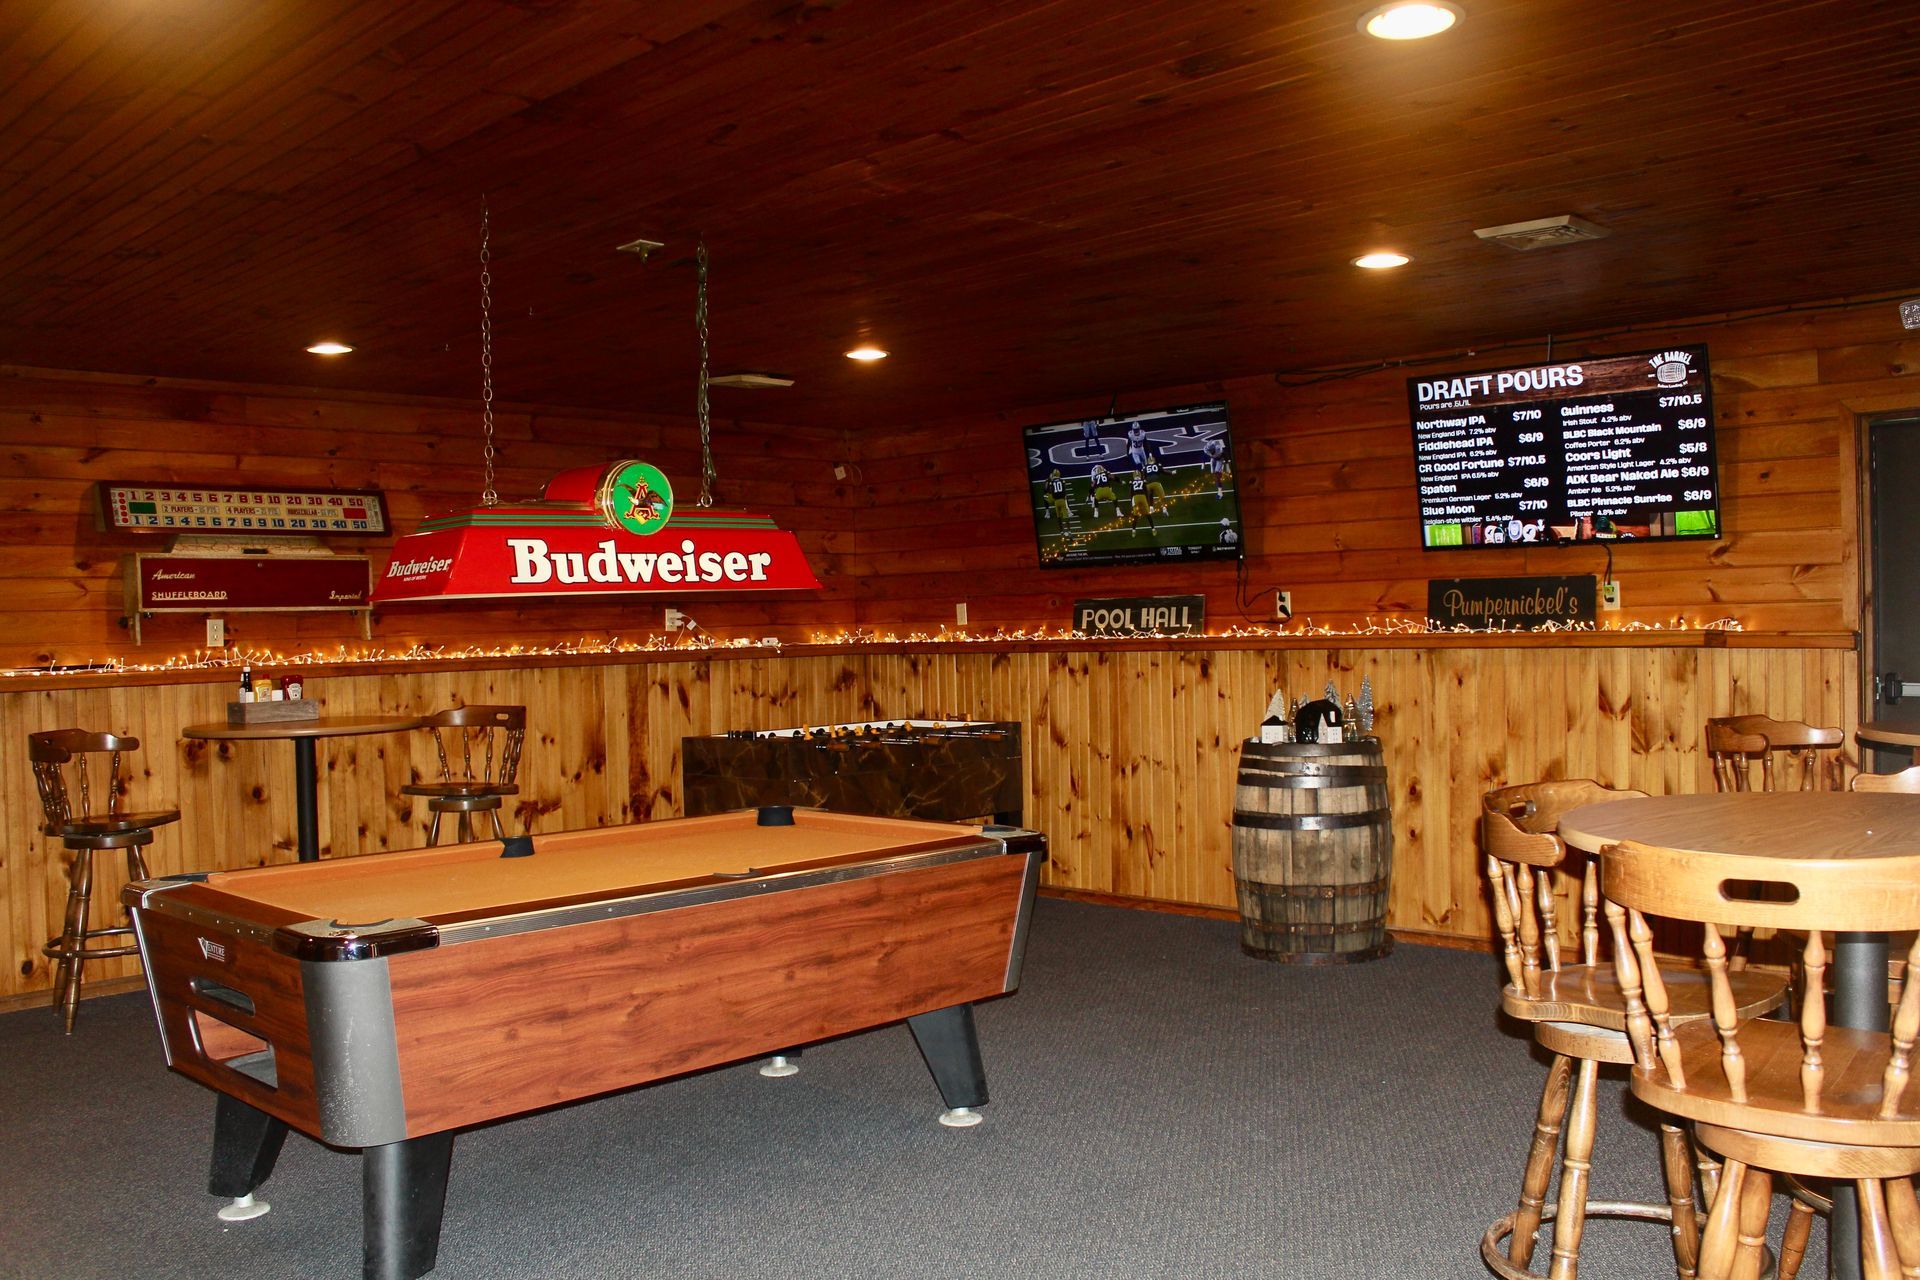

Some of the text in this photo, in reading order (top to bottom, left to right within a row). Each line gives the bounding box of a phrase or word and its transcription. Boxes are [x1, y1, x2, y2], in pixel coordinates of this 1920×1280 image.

[1648, 351, 1692, 368] THE BARREL
[1417, 365, 1584, 402] DRAFT POURS
[1420, 403, 1440, 411] Pours
[1561, 394, 1702, 417] Guinness $7/10.5
[1416, 409, 1542, 430] Northway IPA $7/10
[1432, 430, 1455, 439] England
[1563, 418, 1706, 439] BLBC Black Mountain $6/9
[1418, 432, 1544, 452] Fiddlehead IPA $6/9
[1432, 452, 1456, 460] England
[1565, 442, 1707, 462] Coors Light $5/8
[1419, 455, 1546, 473] CR Good Fortune $7/10.5
[1599, 462, 1616, 470] Style
[1617, 461, 1634, 469] Light
[1434, 474, 1458, 482] England
[1566, 466, 1709, 485] ADK Bear Naked Ale $6/9
[1053, 481, 1063, 493] 10
[1132, 480, 1144, 490] 27
[1421, 477, 1549, 495] Spaten $6/9
[130, 491, 363, 506] 1 2 3 4 5 6 7 8 9 10 20 30 40 50
[1567, 490, 1712, 508] BLBC Pinnacle Sunrise $6/9
[234, 507, 255, 515] PLAYERS
[1422, 500, 1548, 516] Blue Moon $7/10
[134, 516, 367, 529] 1 2 3 4 5 6 7 8 9 10 20 30 40 50
[386, 556, 452, 578] Budweiser
[506, 538, 772, 584] Budweiser
[152, 568, 195, 580] American
[152, 591, 228, 600] SHUFFLEBOARD
[329, 590, 362, 602] Imperial
[1443, 587, 1578, 624] Pumpernickel's
[1082, 606, 1192, 629] POOL HALL
